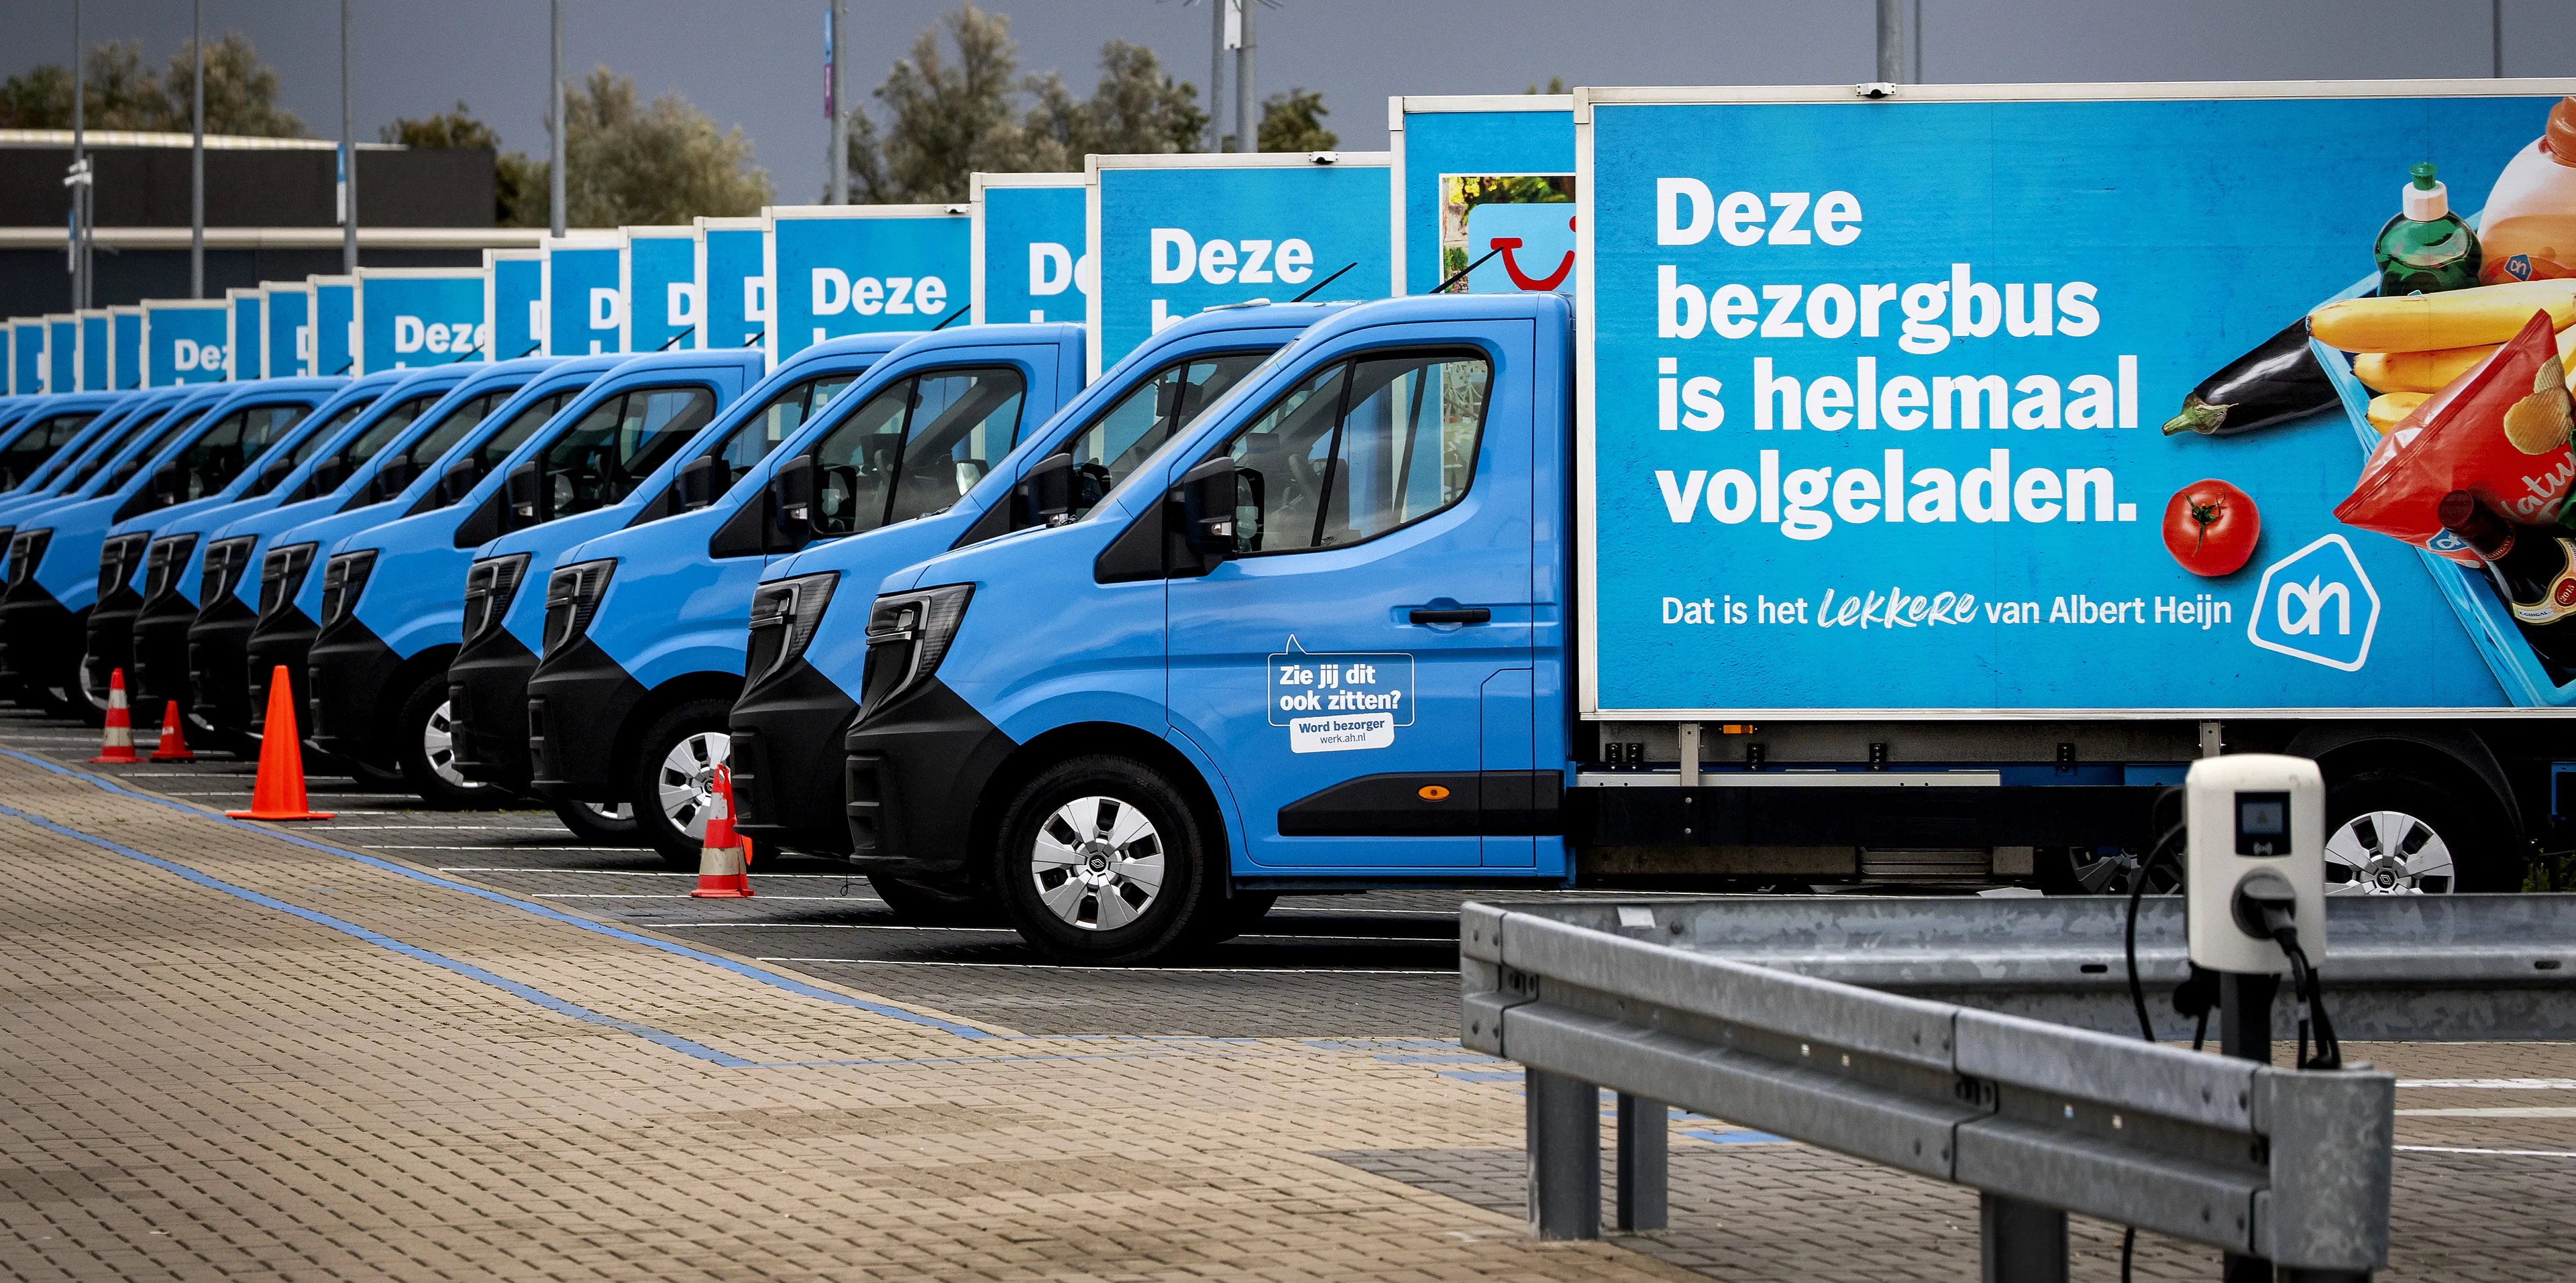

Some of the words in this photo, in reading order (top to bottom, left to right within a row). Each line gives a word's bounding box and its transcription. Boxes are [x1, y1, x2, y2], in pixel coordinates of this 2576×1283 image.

[1656, 177, 1862, 247] Deze
[1150, 228, 1313, 284] Deze
[812, 268, 947, 315] Deze
[1658, 263, 2101, 355] bezorgbus
[1658, 357, 1725, 431] is
[1754, 355, 2139, 431] helemaal
[1655, 448, 2137, 541] volgeladen.
[1662, 597, 1715, 624] Dat
[1724, 595, 1748, 624] is
[1758, 595, 1808, 624] het
[1984, 602, 2039, 624] van
[2049, 594, 2145, 624] Albert
[2155, 594, 2231, 630] Heijn
[1279, 665, 1313, 685] Zie
[1318, 664, 1338, 689] jij
[1346, 663, 1376, 684] dit
[1280, 690, 1322, 711] ook
[1328, 689, 1401, 710] zitten?
[1299, 722, 1330, 733] Word
[1334, 719, 1385, 732] bezorger
[1320, 732, 1366, 744] werk.ah.nl
